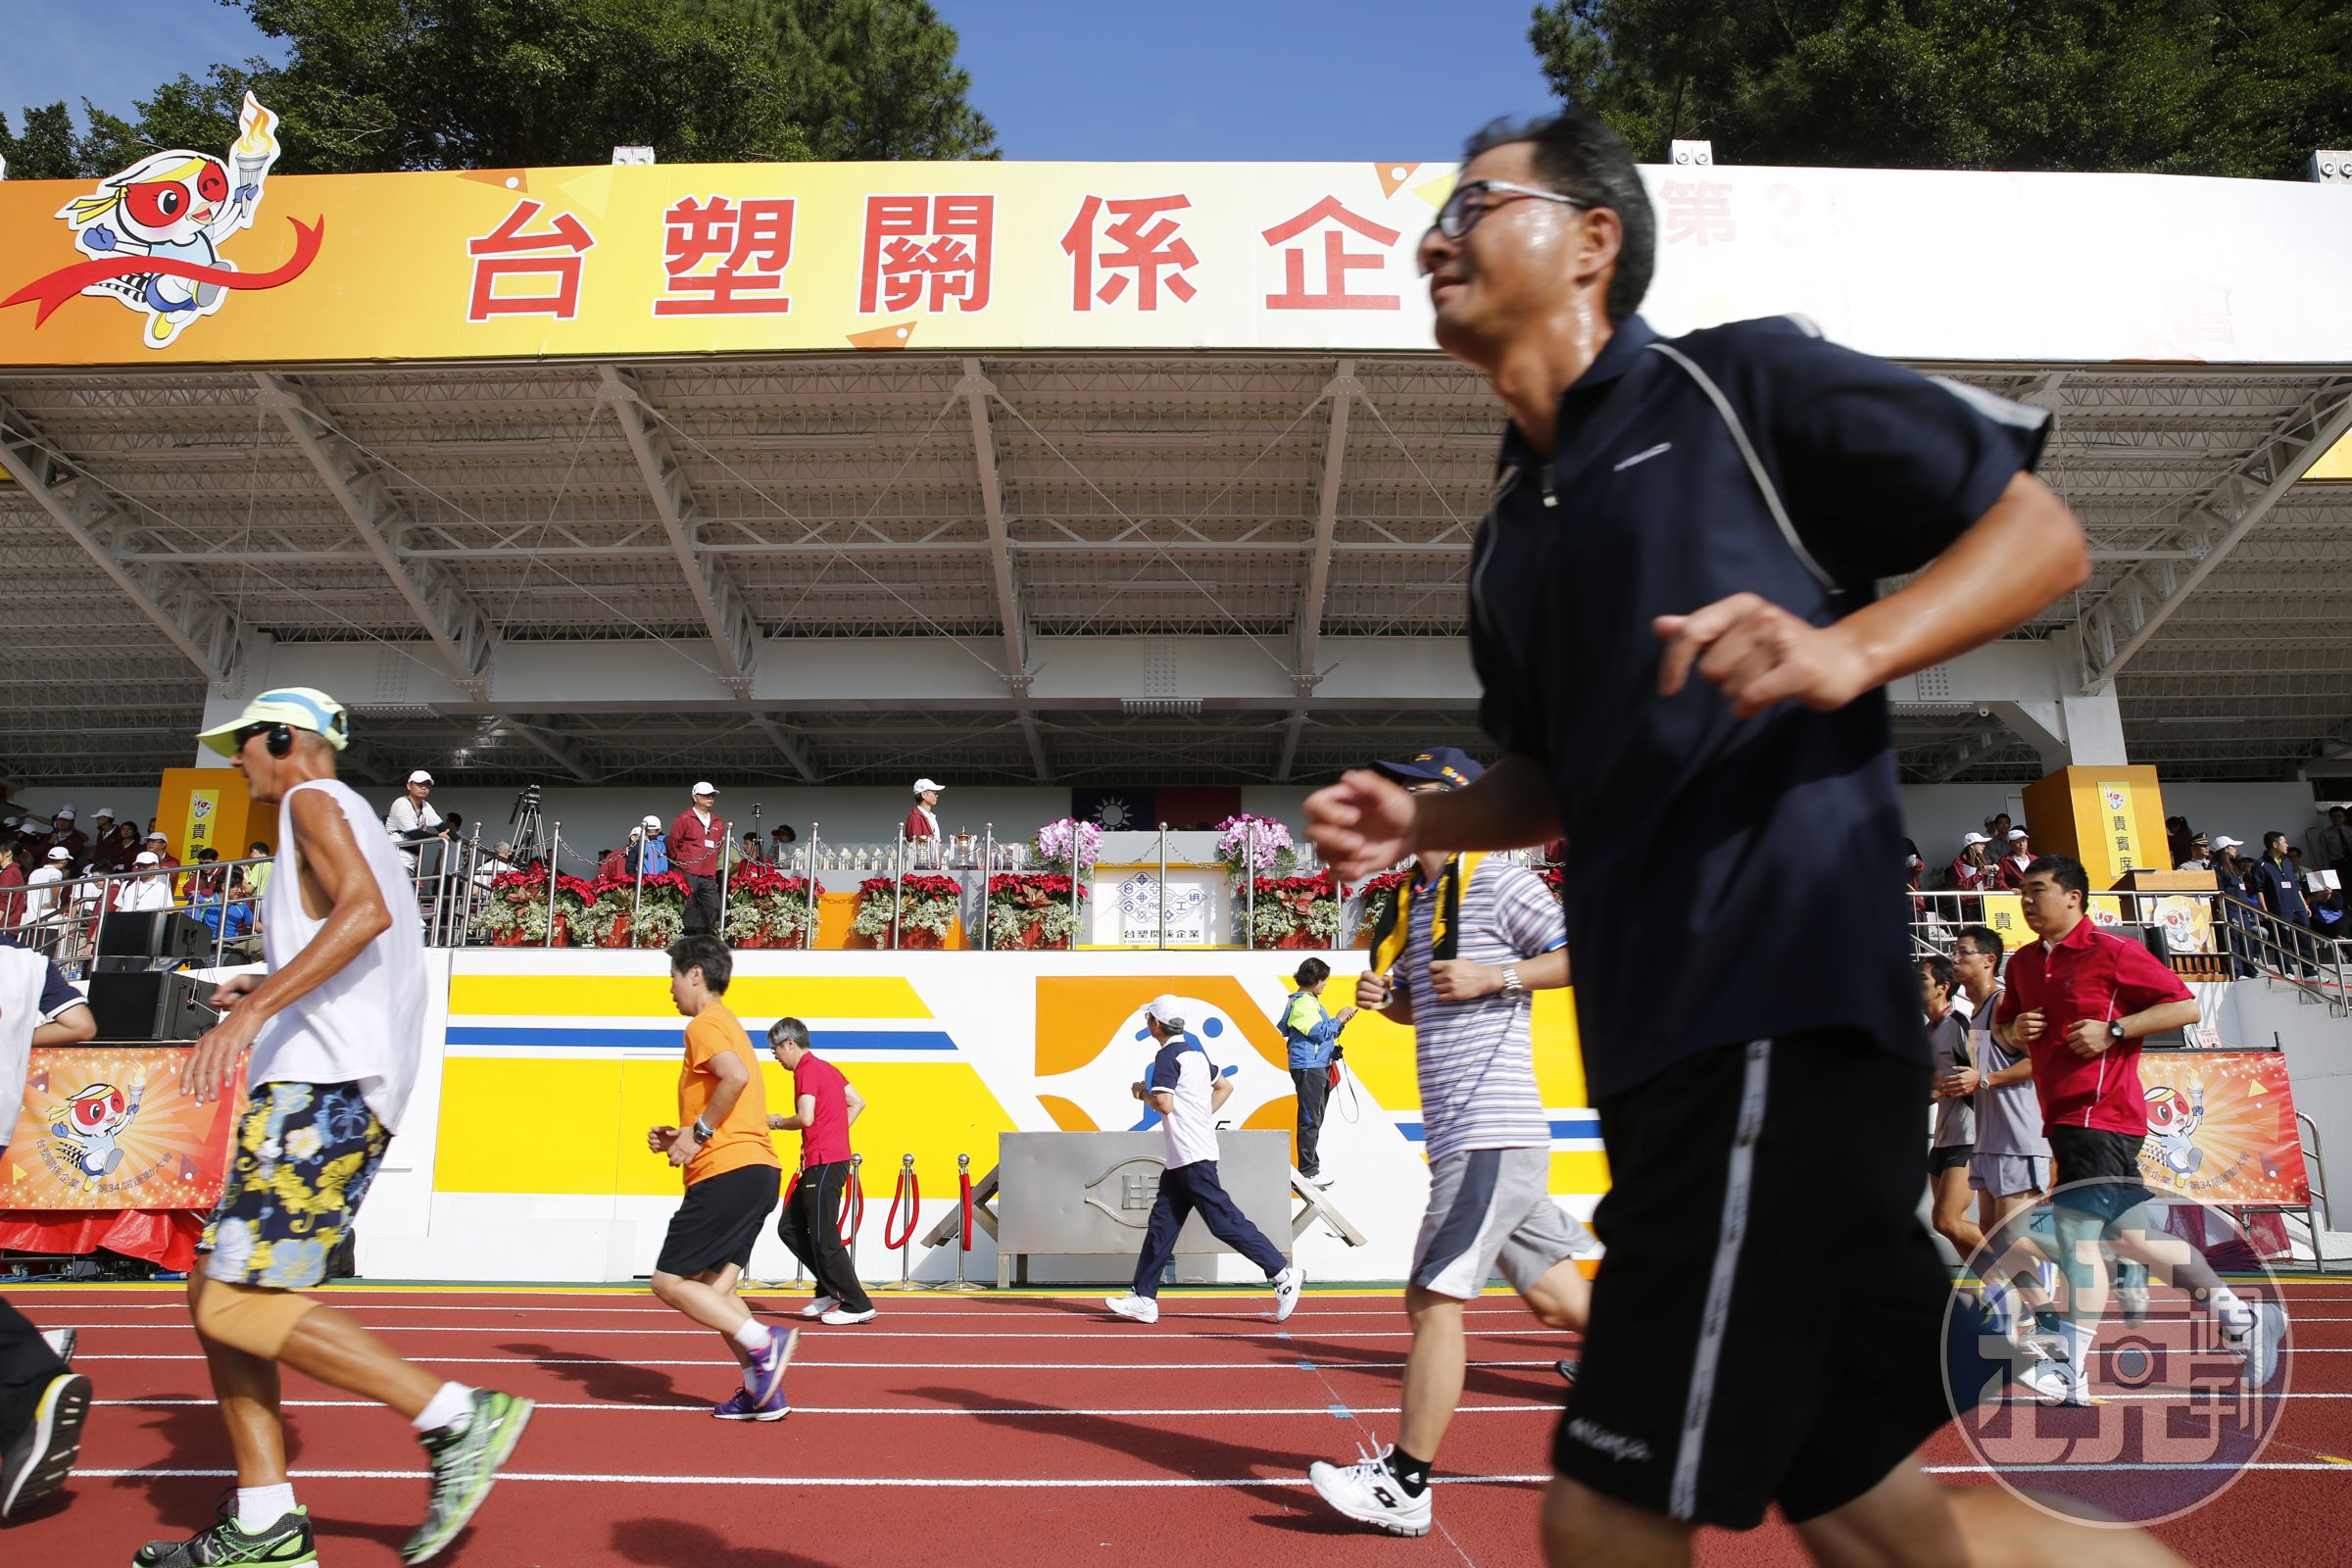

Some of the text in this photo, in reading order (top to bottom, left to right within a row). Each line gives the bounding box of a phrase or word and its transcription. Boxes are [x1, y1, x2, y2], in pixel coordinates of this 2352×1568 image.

[2112, 814, 2133, 872] 貴賓席
[1993, 911, 2013, 931] 貴
[35, 1138, 172, 1194] 台塑關係企業 第34屆運動大會
[2189, 1151, 2251, 1191] 第34屆運動大會
